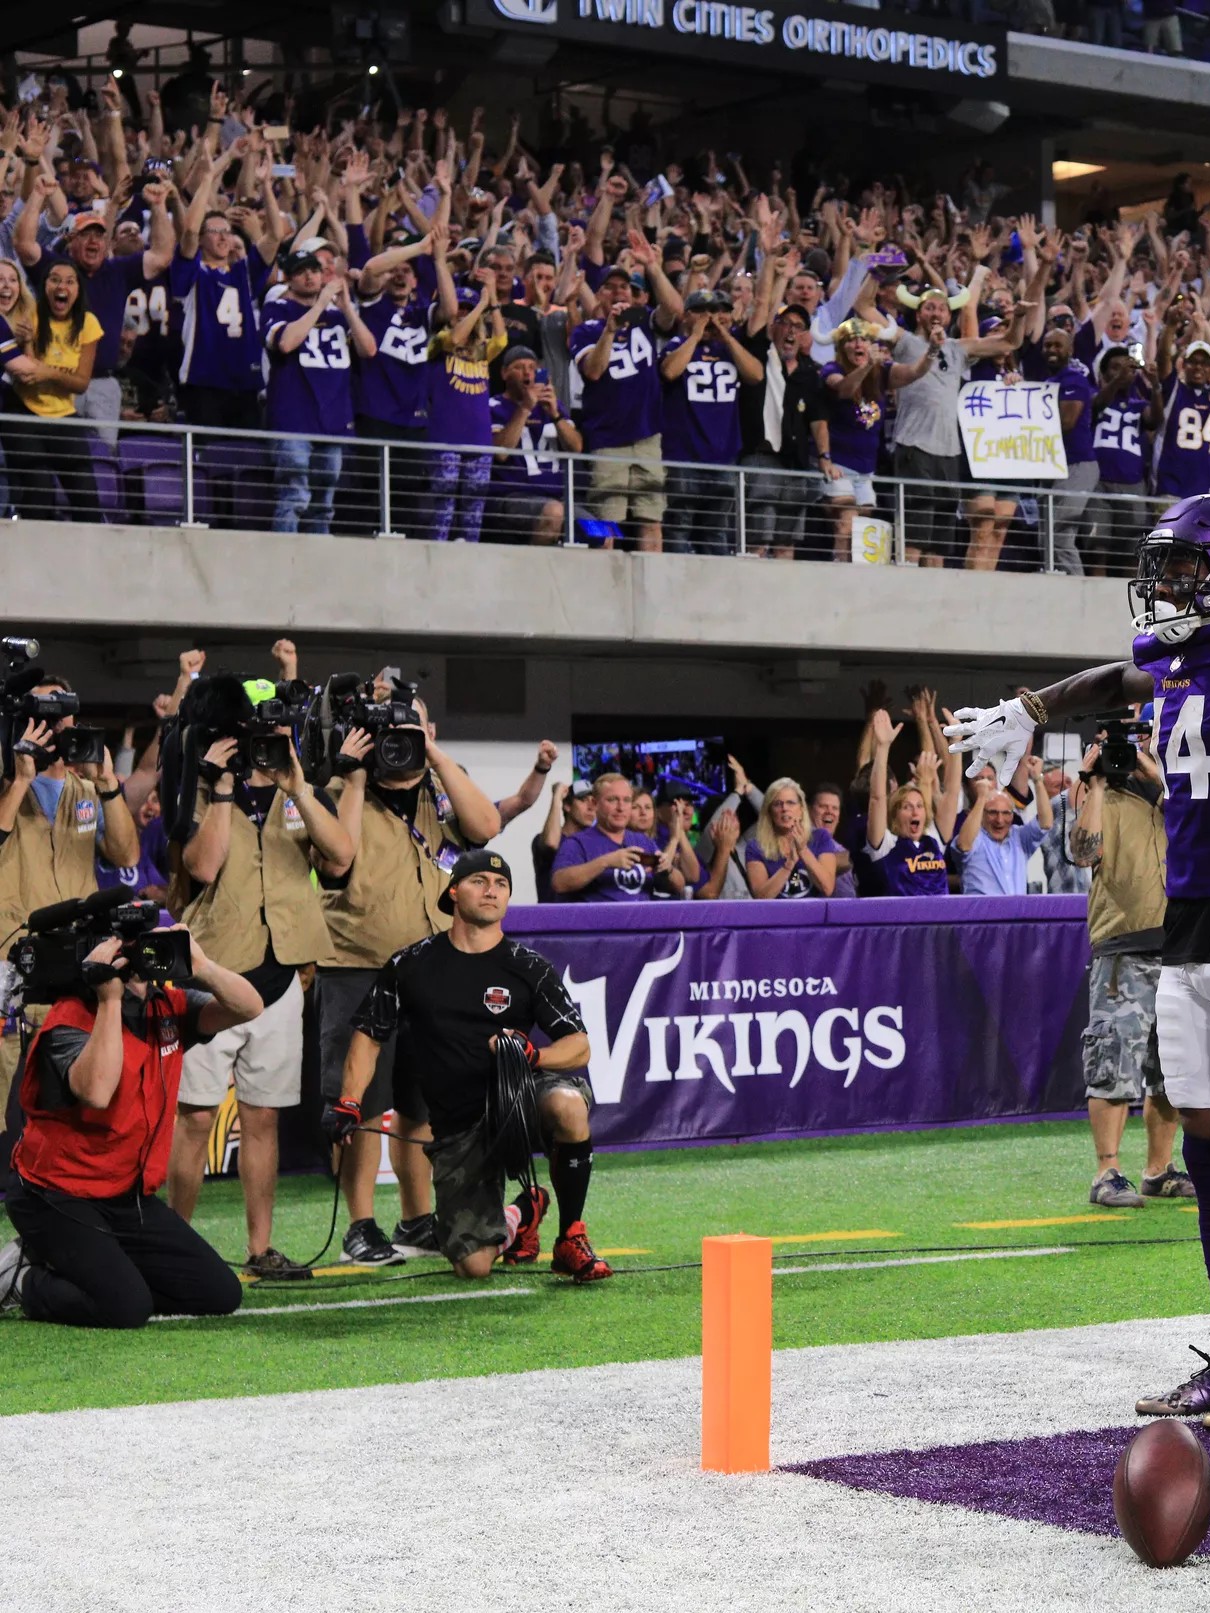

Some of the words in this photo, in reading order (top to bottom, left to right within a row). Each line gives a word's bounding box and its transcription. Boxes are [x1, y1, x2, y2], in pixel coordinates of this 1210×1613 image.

[673, 0, 775, 45] CITIES
[783, 15, 997, 77] ORTHOPEDICS
[217, 287, 242, 338] 4
[299, 325, 350, 369] 33
[609, 327, 652, 380] 54
[686, 360, 738, 402] 22
[521, 423, 560, 477] 14
[1094, 408, 1142, 456] 22
[1161, 676, 1191, 692] VIKINGS
[905, 857, 946, 873] VIKING
[689, 977, 838, 1003] MINNESOTA
[563, 931, 906, 1105] VIKINGS
